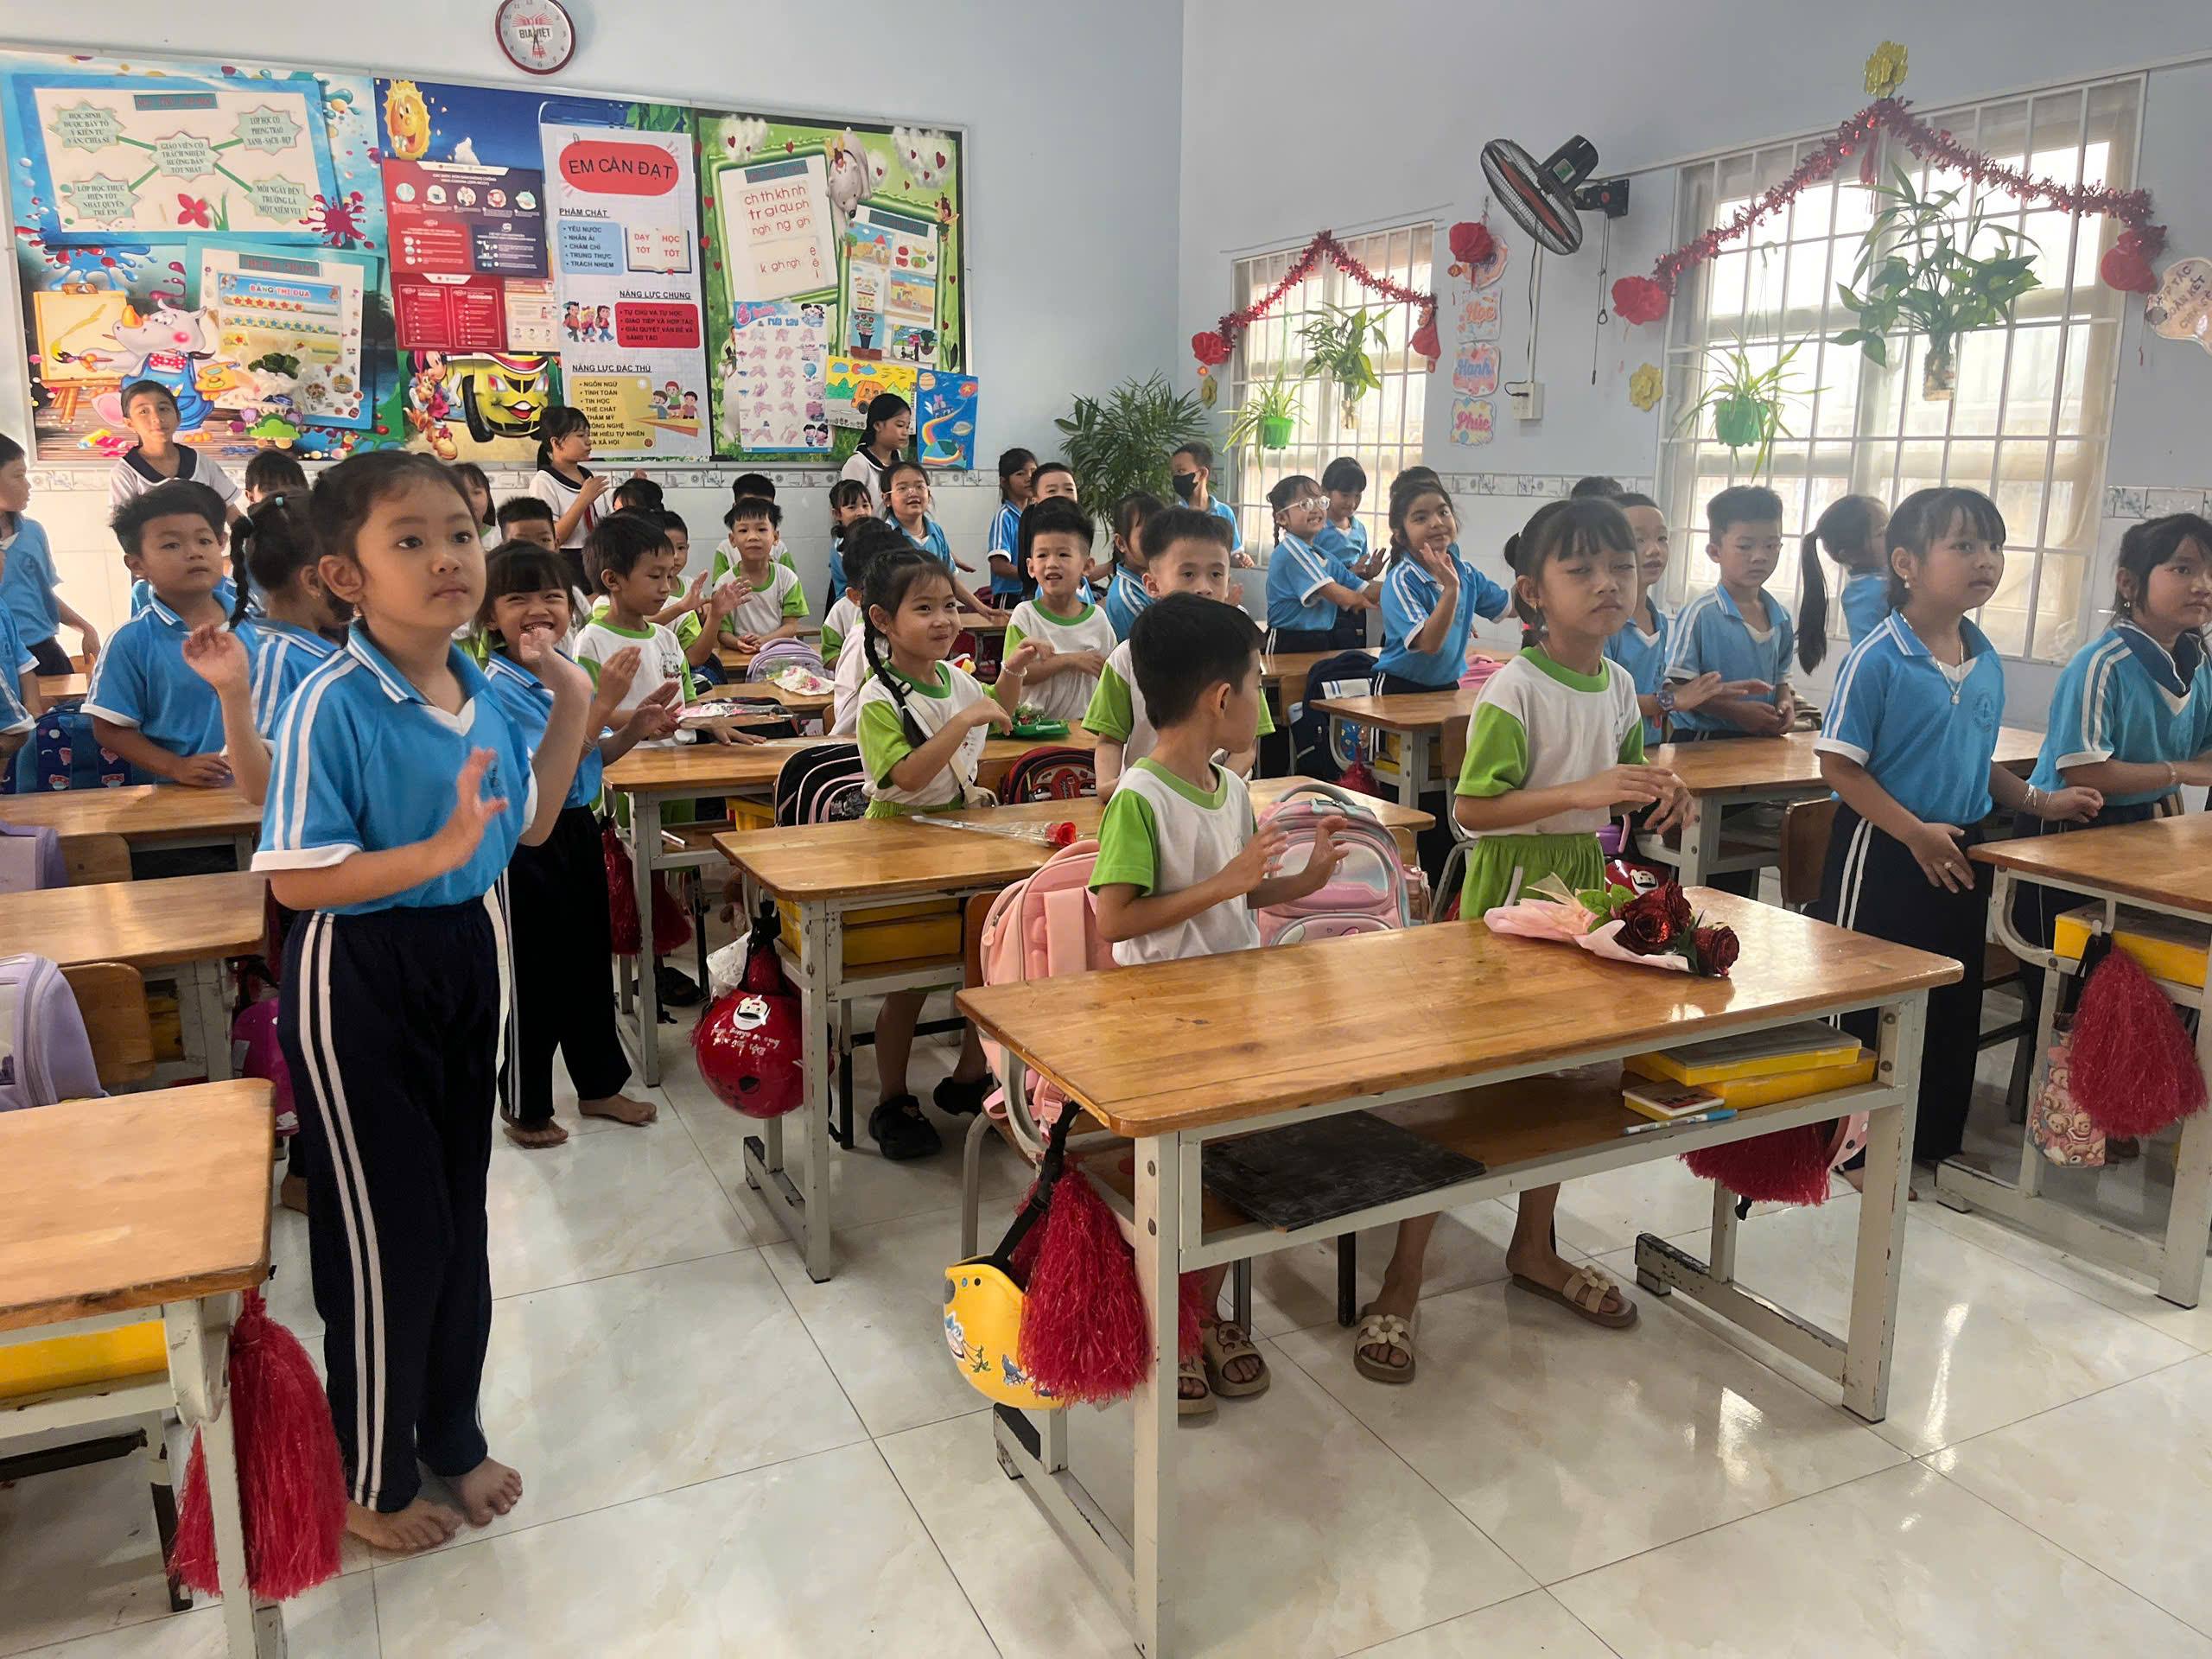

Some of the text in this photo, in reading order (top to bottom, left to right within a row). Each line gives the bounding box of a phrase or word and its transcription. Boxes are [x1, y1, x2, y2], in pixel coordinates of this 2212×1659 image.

[519, 29, 533, 39] BIA
[569, 159, 594, 175] EM
[638, 161, 673, 180] ĐẠT
[745, 184, 806, 205] ch th kh nh
[748, 209, 761, 220] tr
[779, 202, 793, 214] qu
[795, 200, 810, 211] ph
[753, 216, 810, 236] ngh ng gh
[662, 235, 680, 244] HỌC
[810, 246, 817, 256] e
[760, 257, 801, 274] k gh ngh
[645, 290, 662, 299] LỰC
[1455, 410, 1491, 432] Phúc
